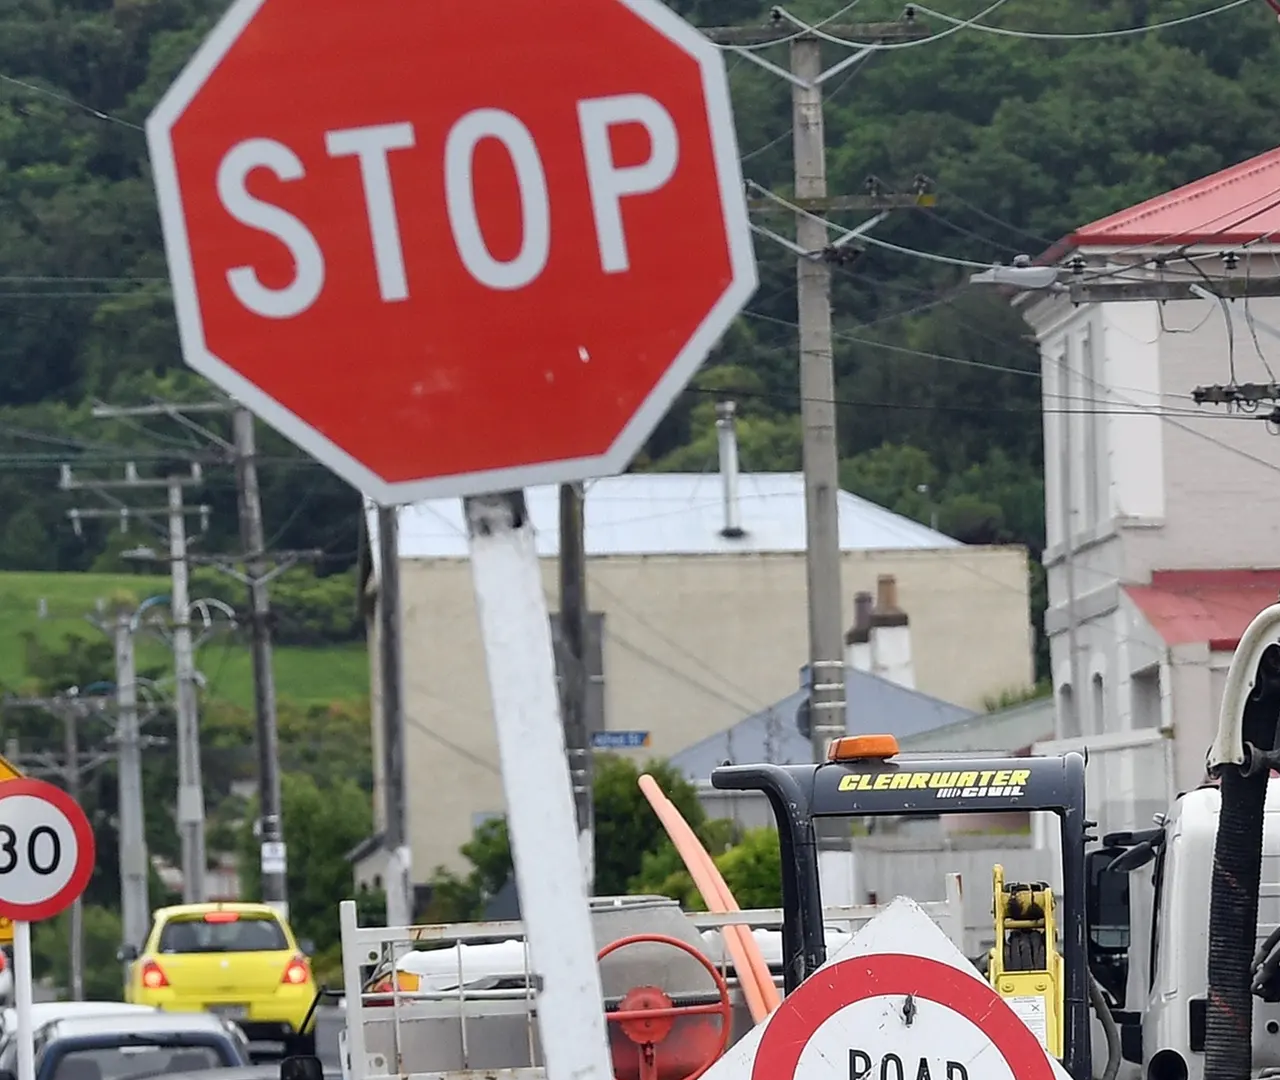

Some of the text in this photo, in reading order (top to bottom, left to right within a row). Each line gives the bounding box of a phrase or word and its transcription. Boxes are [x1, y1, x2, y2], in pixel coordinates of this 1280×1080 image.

[216, 93, 679, 319] STOP
[838, 770, 1031, 790] CLEARWATER
[961, 786, 1024, 798] CIVIL
[0, 824, 61, 876] 30
